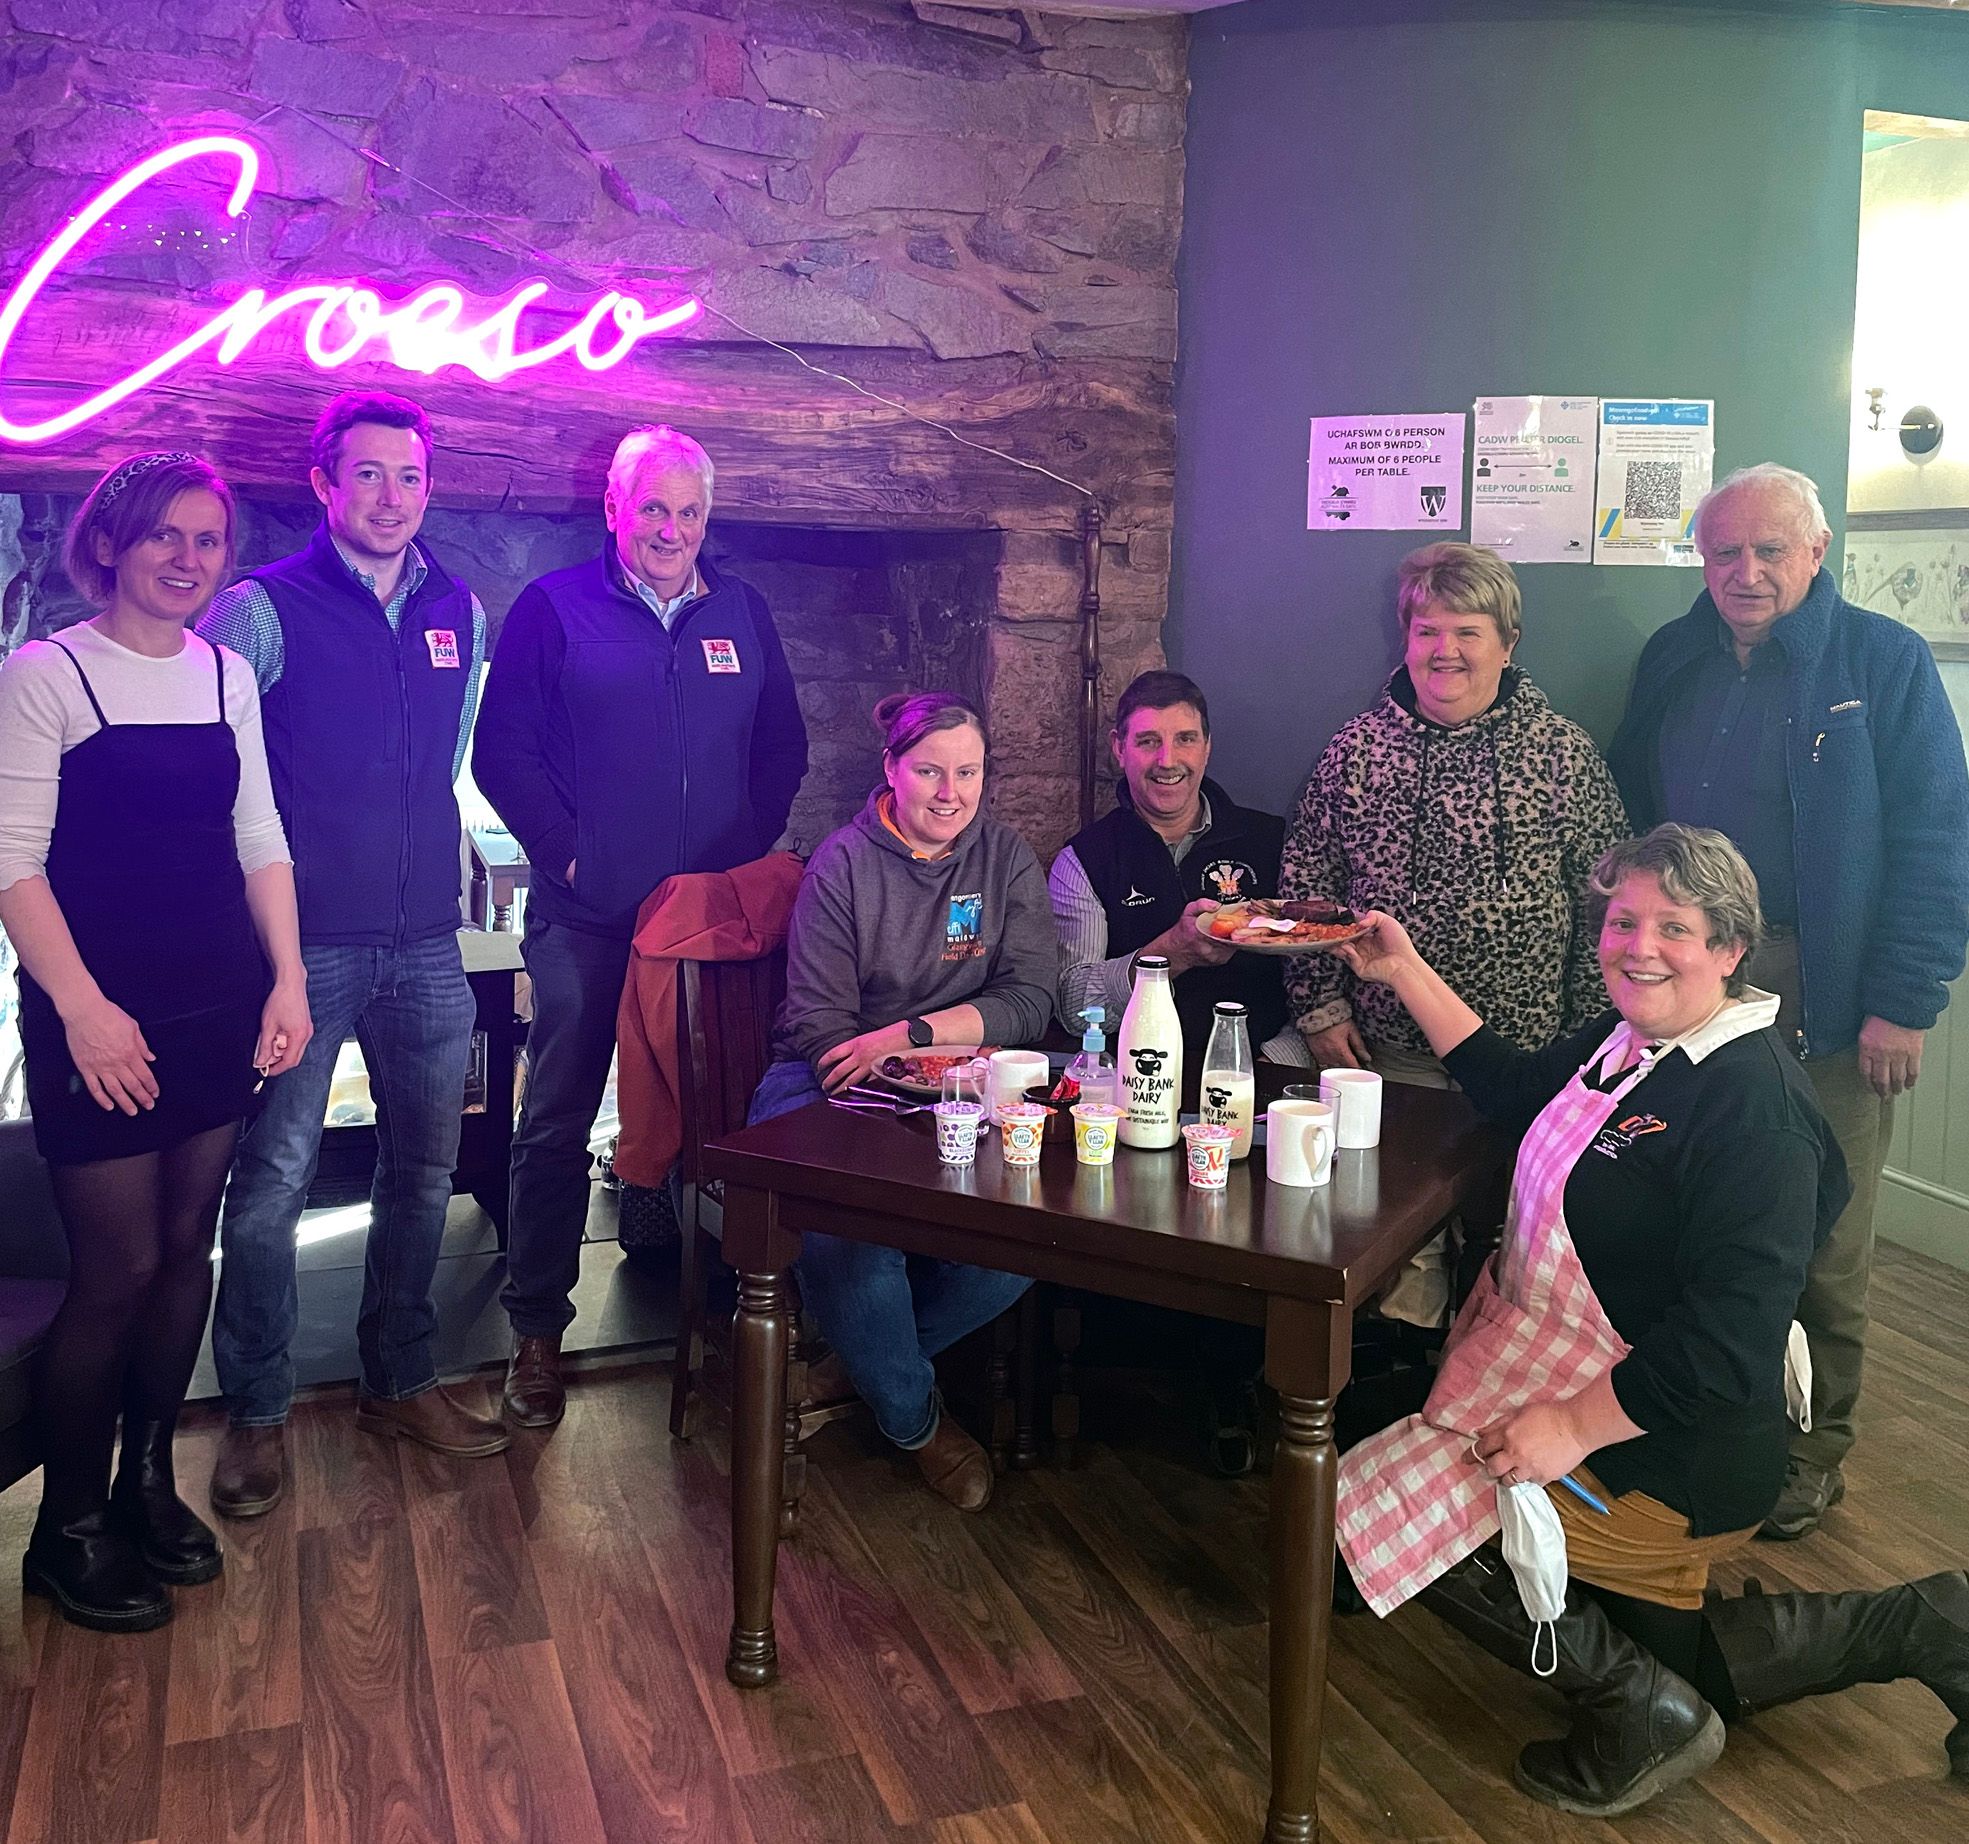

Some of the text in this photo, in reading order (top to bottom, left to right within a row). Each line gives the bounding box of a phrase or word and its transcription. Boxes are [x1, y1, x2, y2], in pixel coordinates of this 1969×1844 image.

[0, 137, 696, 443] Croeso
[1327, 429, 1382, 438] UCHAFSWM
[1403, 427, 1445, 437] PERSON
[1478, 435, 1508, 444] CADW
[1344, 441, 1357, 450] AR
[1328, 455, 1441, 465] MAXIMUM OF 6 PEOPLE
[1355, 467, 1411, 477] PER TABLE.
[1476, 484, 1576, 493] KEEP YOUR DISTANCE.
[434, 647, 456, 658] FUW
[710, 654, 733, 663] FUW
[1122, 1074, 1174, 1091] DAISY BANK
[1132, 1091, 1161, 1104] DAIRY
[1217, 1108, 1239, 1120] BANK
